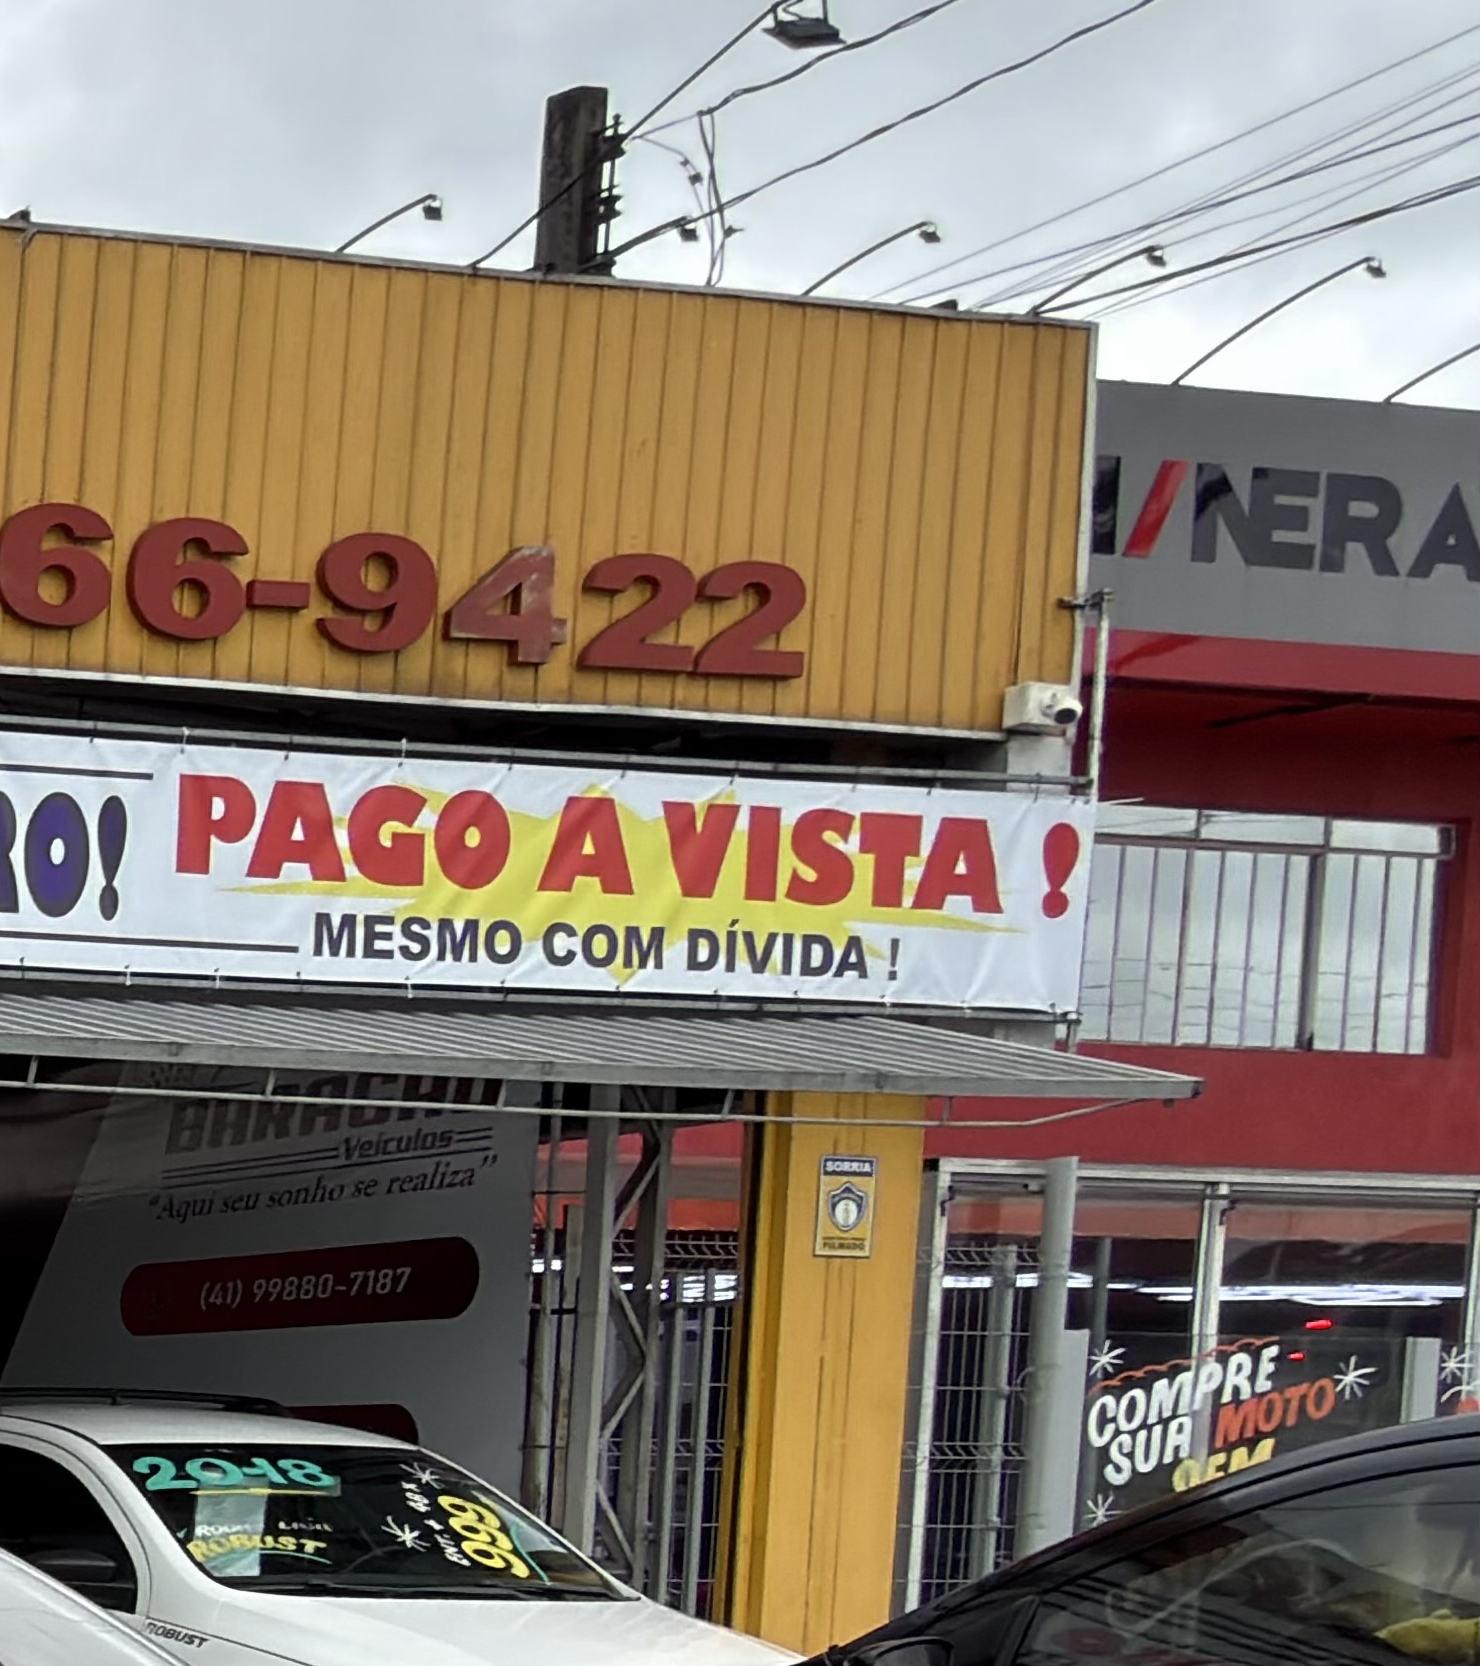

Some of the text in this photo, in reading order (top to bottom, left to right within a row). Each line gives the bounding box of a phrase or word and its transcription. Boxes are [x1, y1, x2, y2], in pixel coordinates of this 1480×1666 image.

[174, 773, 1081, 920] PAGO A VISTA !
[312, 911, 901, 981] MESMO COM DÍVIDA !
[342, 1127, 455, 1161] Veículos
[218, 1192, 259, 1214] seu
[265, 1175, 346, 1210] sonho
[352, 1178, 381, 1198] se
[199, 1265, 413, 1311] (41) 99880-7187
[1087, 1344, 1280, 1448] COMPRE
[1103, 1376, 1336, 1486] SUA MOTO
[132, 1455, 336, 1492] 2018
[186, 1533, 328, 1564] ROBUST
[144, 1621, 210, 1649] ROBUST
